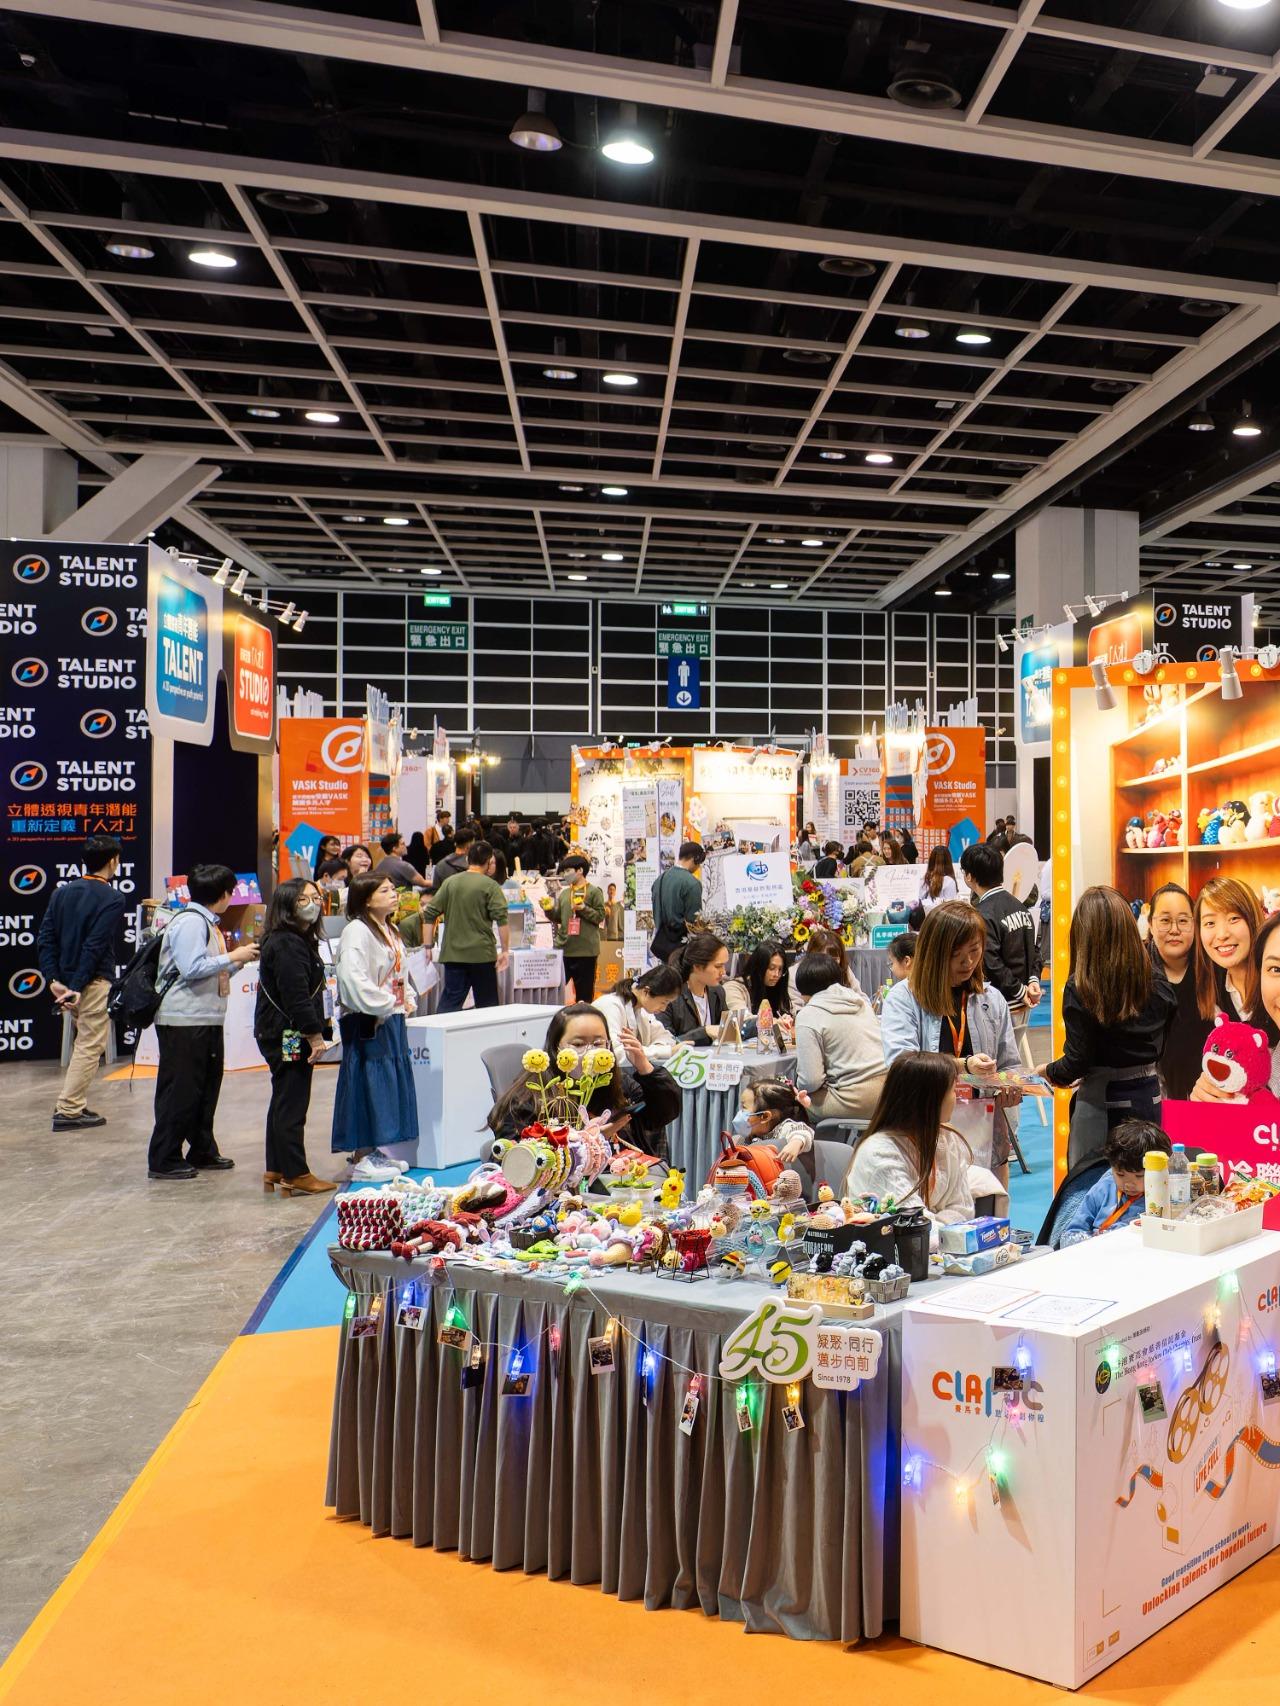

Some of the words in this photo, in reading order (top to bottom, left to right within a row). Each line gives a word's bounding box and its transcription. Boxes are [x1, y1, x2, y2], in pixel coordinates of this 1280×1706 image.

[59, 555, 138, 572] TALENT
[58, 572, 138, 588] STUDIO
[1182, 604, 1232, 616] TALENT
[410, 624, 450, 634] EMERGENCY
[452, 626, 466, 634] EXIT
[1182, 617, 1232, 630] STUDIO
[410, 634, 464, 646] 緊急出口
[658, 633, 695, 642] EMERGENCY
[659, 642, 708, 654] 緊急出口
[58, 658, 136, 673] TALENT
[162, 637, 204, 686] TALENT
[58, 674, 137, 690] STUDIO
[239, 668, 270, 705] STUDIO
[56, 760, 136, 775] TALENT
[56, 778, 136, 792] STUDIO
[292, 780, 317, 790] VASK
[318, 780, 348, 790] Studio
[934, 781, 953, 790] VASK
[954, 780, 976, 790] Studio
[7, 803, 137, 817] 立體透視青年潛能
[11, 818, 134, 833] 重新定義「人才」
[56, 863, 134, 878] TALNT
[666, 1050, 708, 1084] 45
[723, 1304, 814, 1376] 45
[817, 1333, 874, 1353] 凝聚·同行
[817, 1352, 869, 1372] 邁步向前
[1124, 1366, 1136, 1376] Hong
[1137, 1359, 1148, 1370] Kong
[818, 1374, 834, 1382] Since
[1196, 1464, 1207, 1492] LIVE
[1208, 1446, 1218, 1474] FULL
[1161, 1570, 1174, 1587] Good
[1175, 1554, 1202, 1575] transition
[1202, 1546, 1215, 1561] from
[1215, 1534, 1232, 1552] school
[1232, 1531, 1237, 1540] to
[1142, 1582, 1180, 1616] Unlocking
[1182, 1563, 1208, 1588] talents
[1208, 1555, 1219, 1570] for
[1220, 1540, 1246, 1562] hopeful
[1247, 1522, 1267, 1543] future
